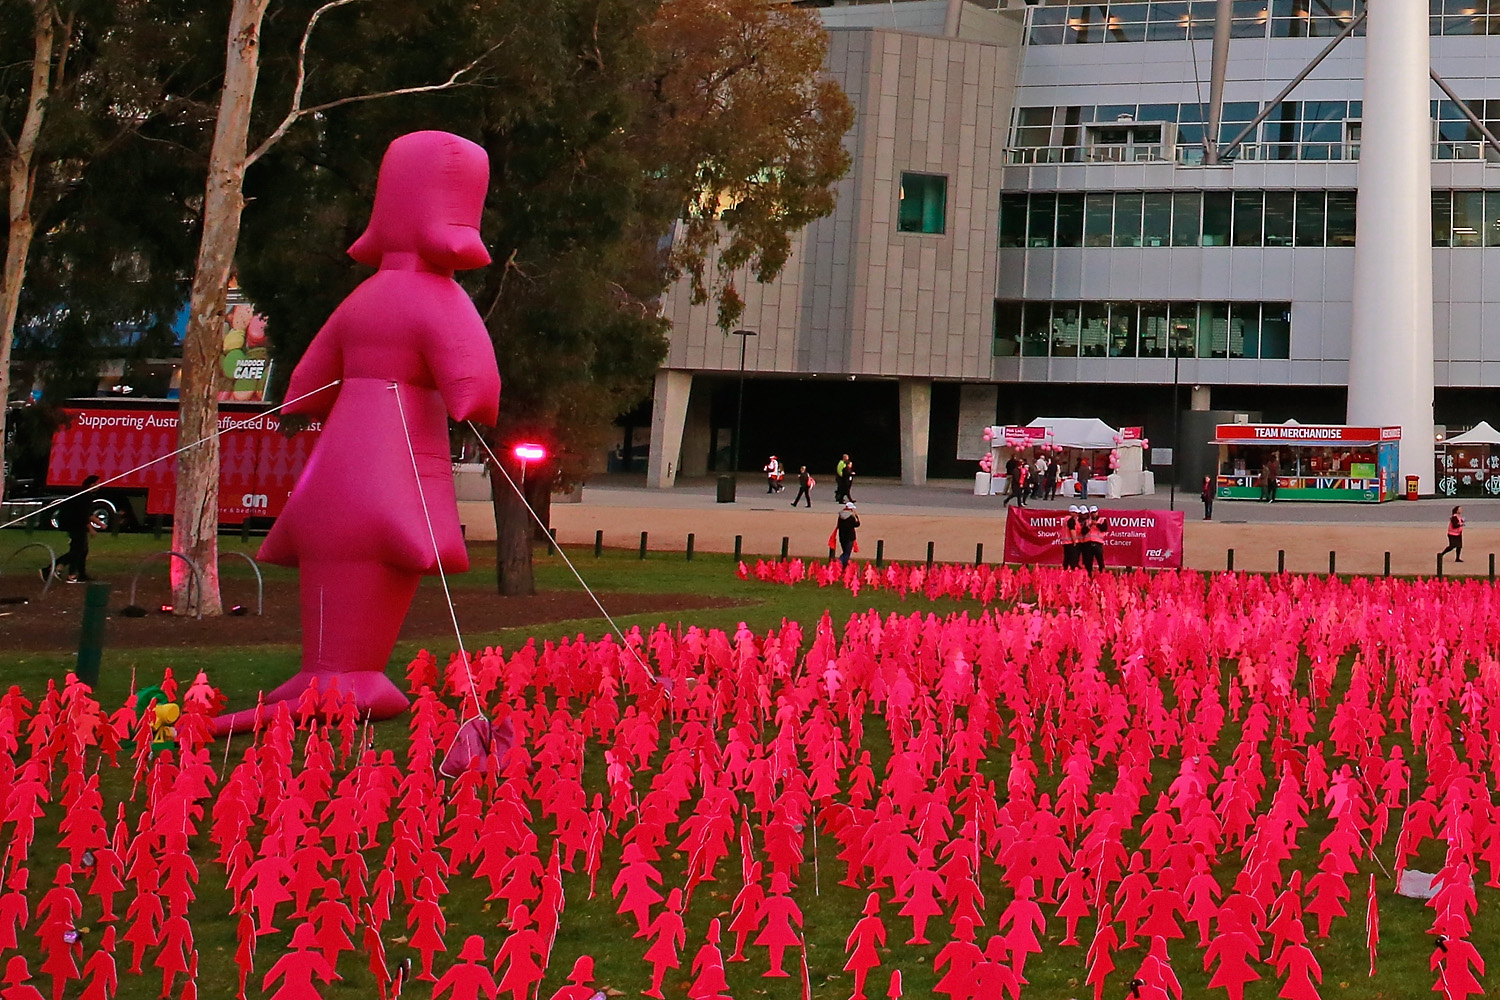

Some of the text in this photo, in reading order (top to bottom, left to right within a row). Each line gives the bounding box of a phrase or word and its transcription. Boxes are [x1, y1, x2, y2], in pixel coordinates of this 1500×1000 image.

[233, 366, 264, 379] CAFE
[78, 413, 144, 431] Supporting
[266, 417, 280, 432] by
[1254, 427, 1342, 439] TEAM MERCHANDISE
[1109, 517, 1155, 528] WOMEN
[1037, 530, 1056, 538] Show
[1110, 530, 1146, 538] Australians
[1110, 538, 1132, 546] Cancer
[1145, 548, 1162, 557] red
